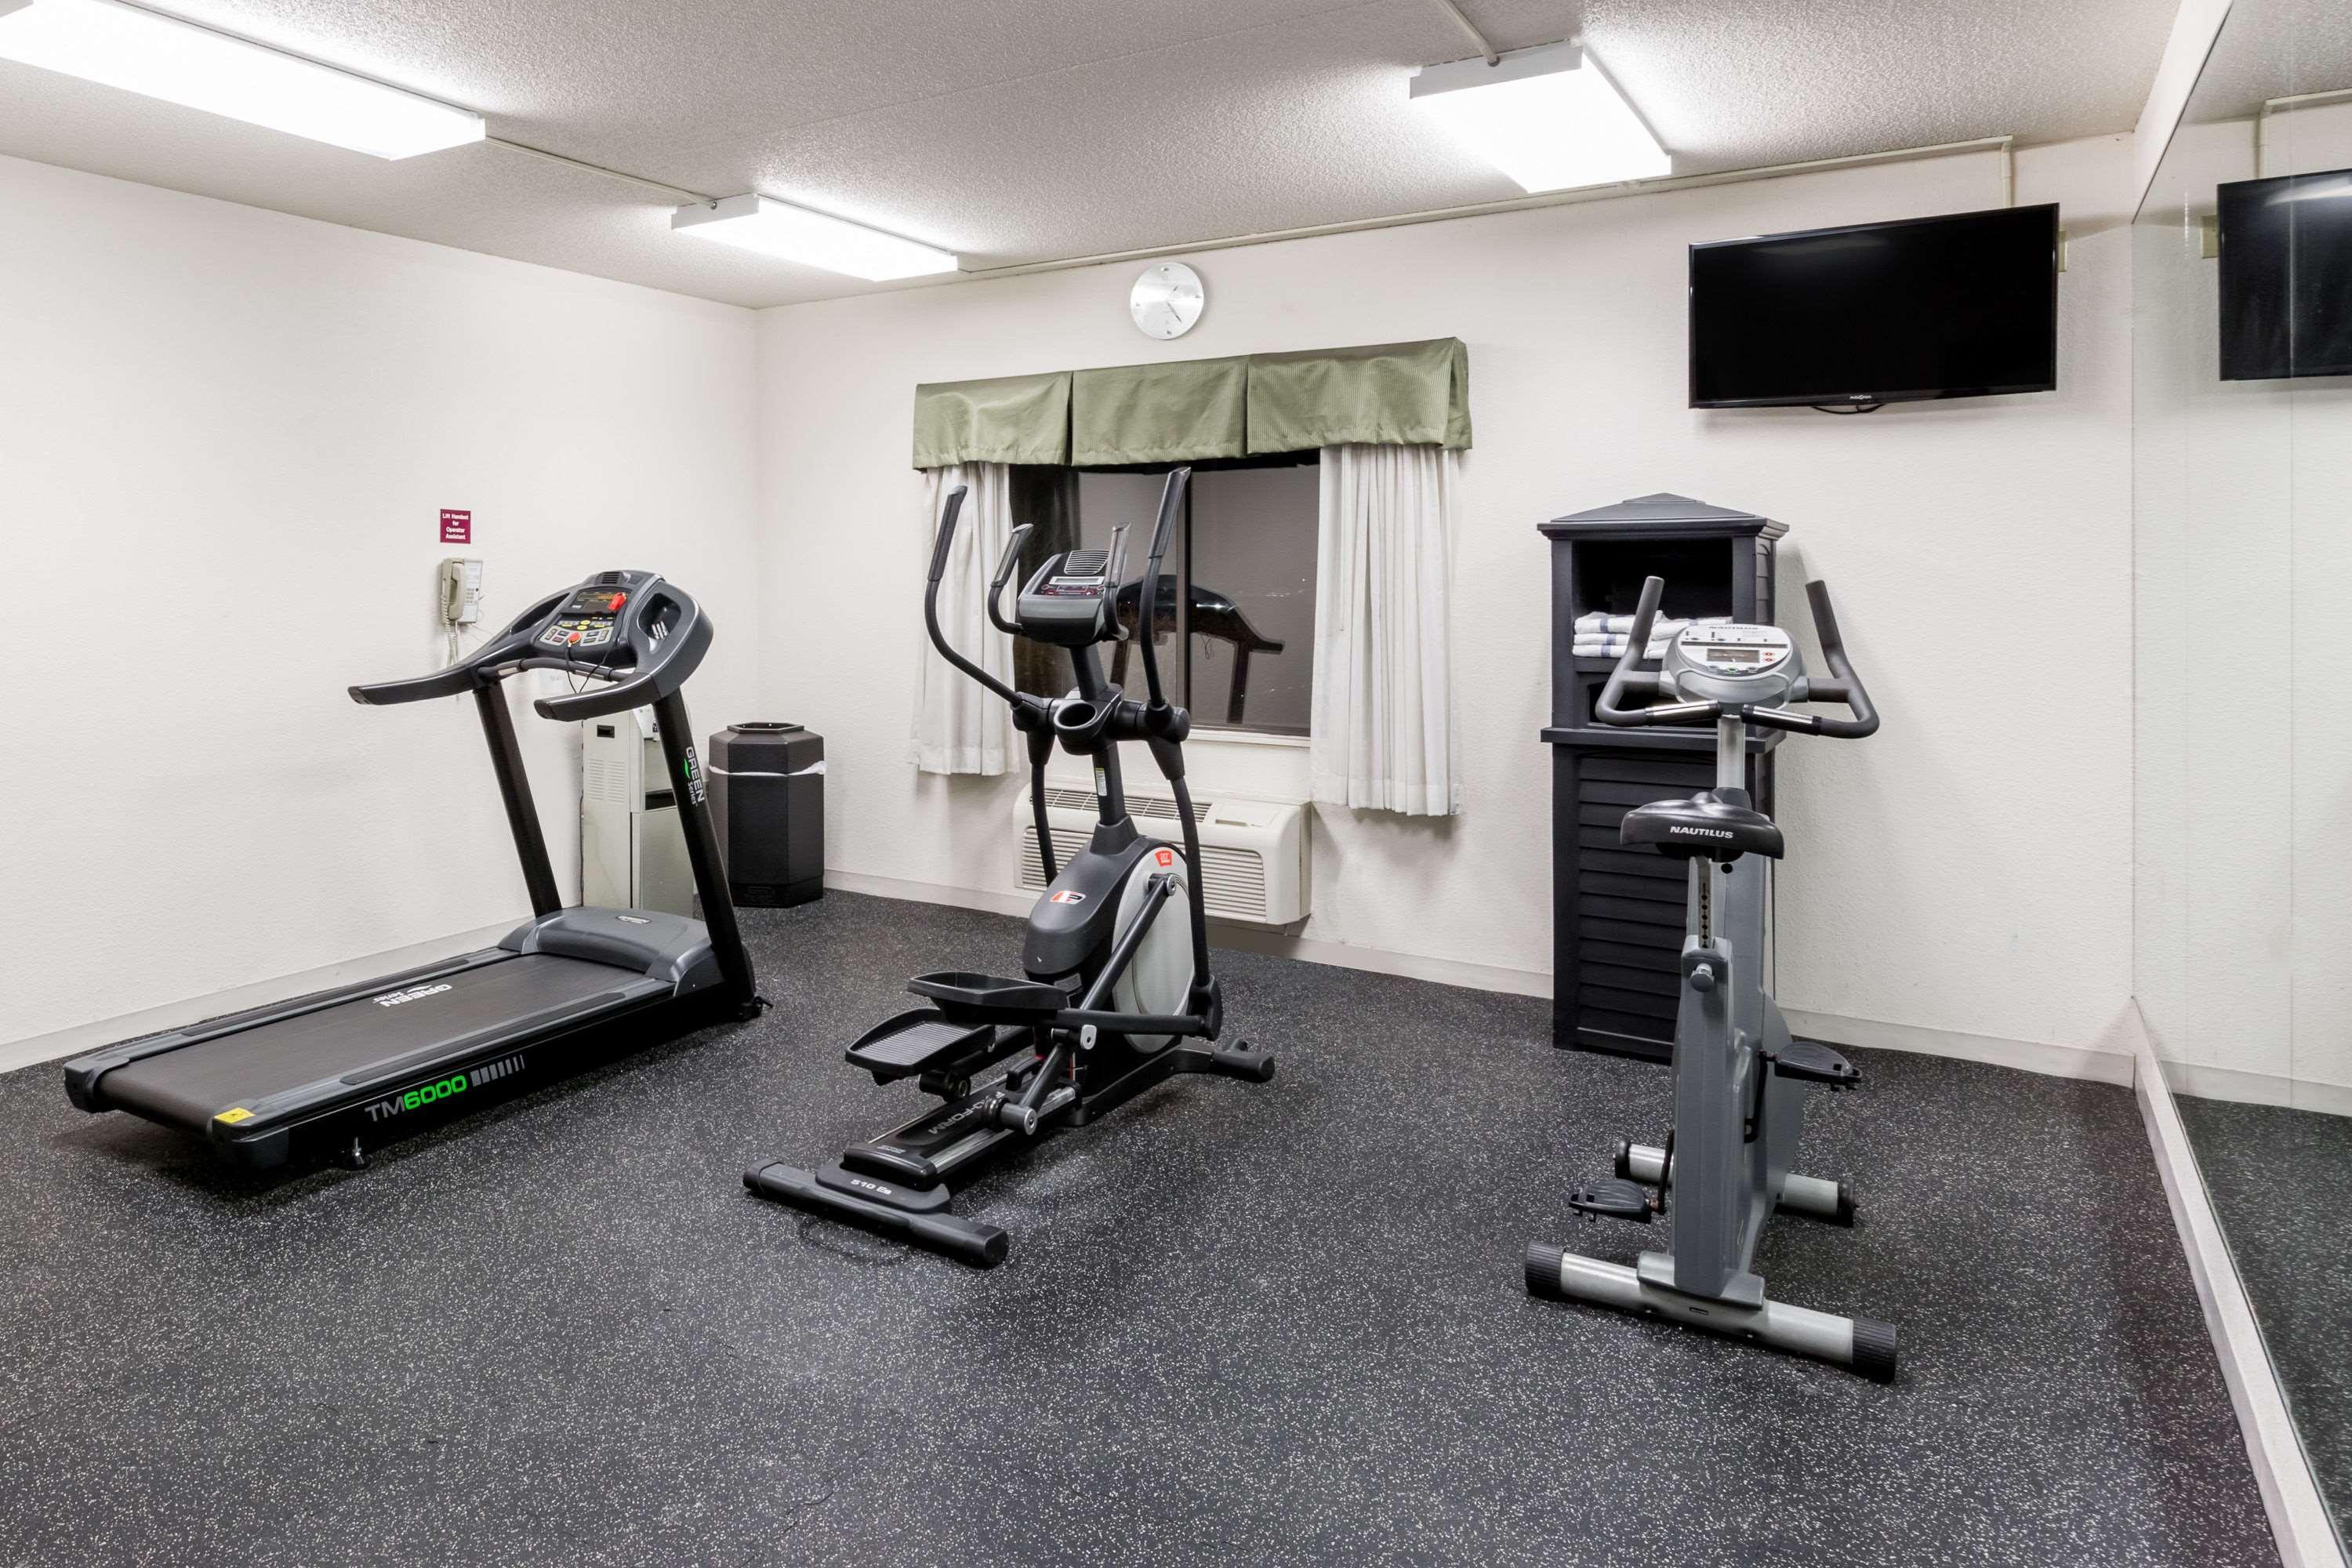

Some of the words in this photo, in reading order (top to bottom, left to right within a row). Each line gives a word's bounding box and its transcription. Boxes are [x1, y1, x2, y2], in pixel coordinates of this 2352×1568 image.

[686, 746, 705, 803] GREEN
[1669, 826, 1734, 839] NAUTILUS
[365, 1075, 467, 1122] TM6000
